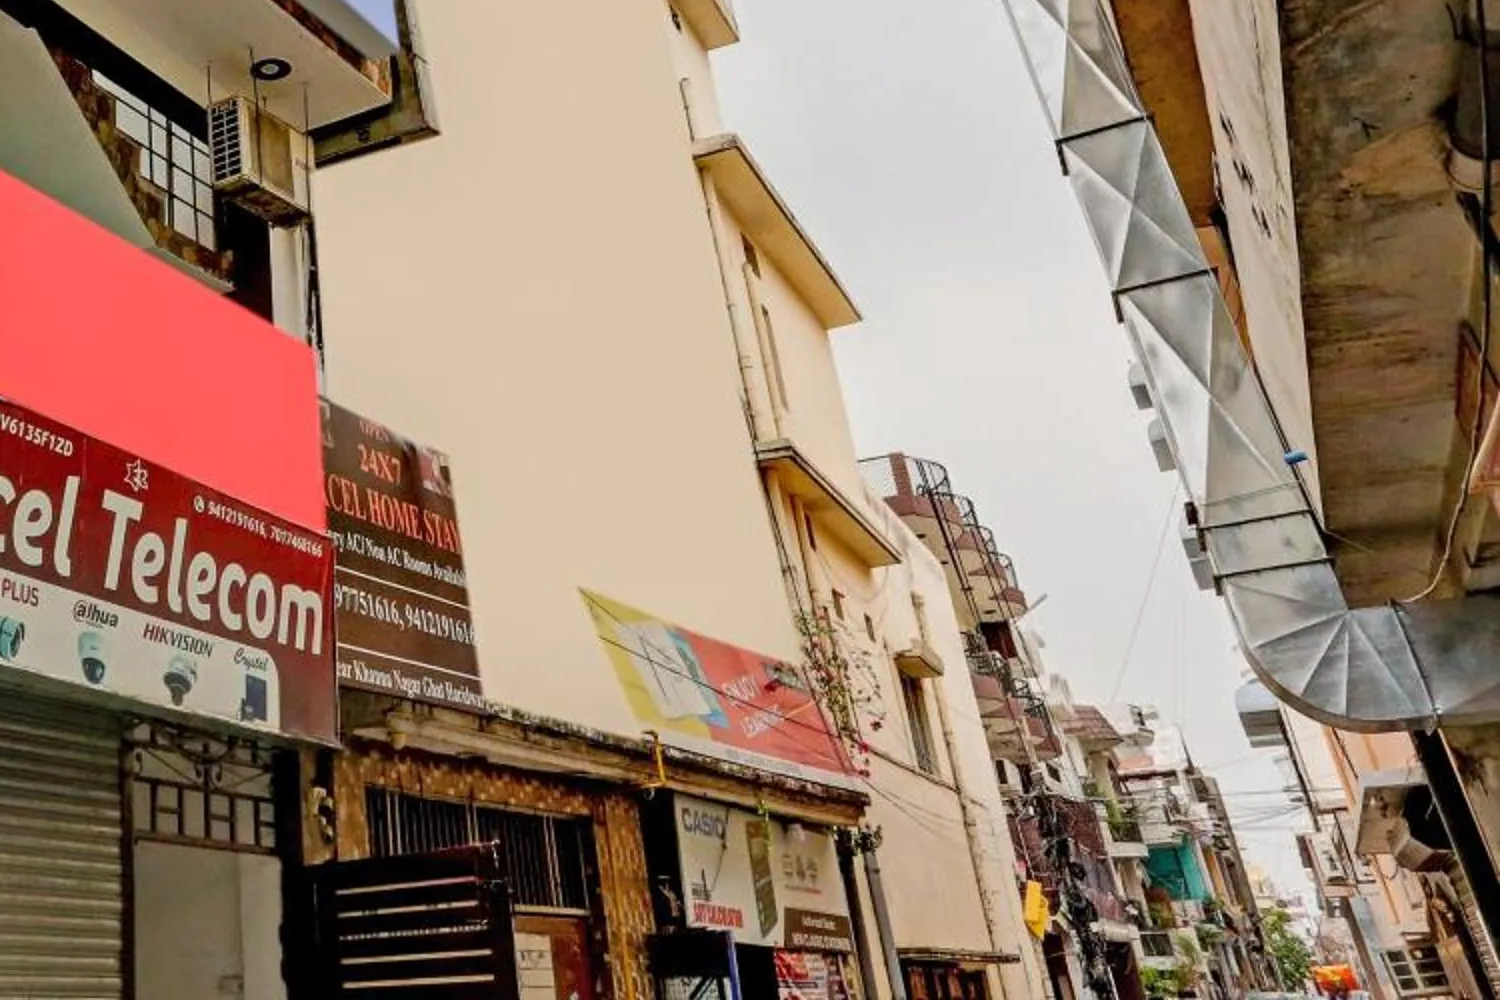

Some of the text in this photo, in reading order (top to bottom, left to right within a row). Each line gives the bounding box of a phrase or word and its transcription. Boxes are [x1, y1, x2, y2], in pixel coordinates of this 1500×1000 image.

[357, 443, 400, 486] 24X7
[367, 487, 422, 541] HOME
[1, 578, 40, 607] PLUS
[102, 488, 323, 655] Telecom
[143, 623, 213, 658] HIKVISION
